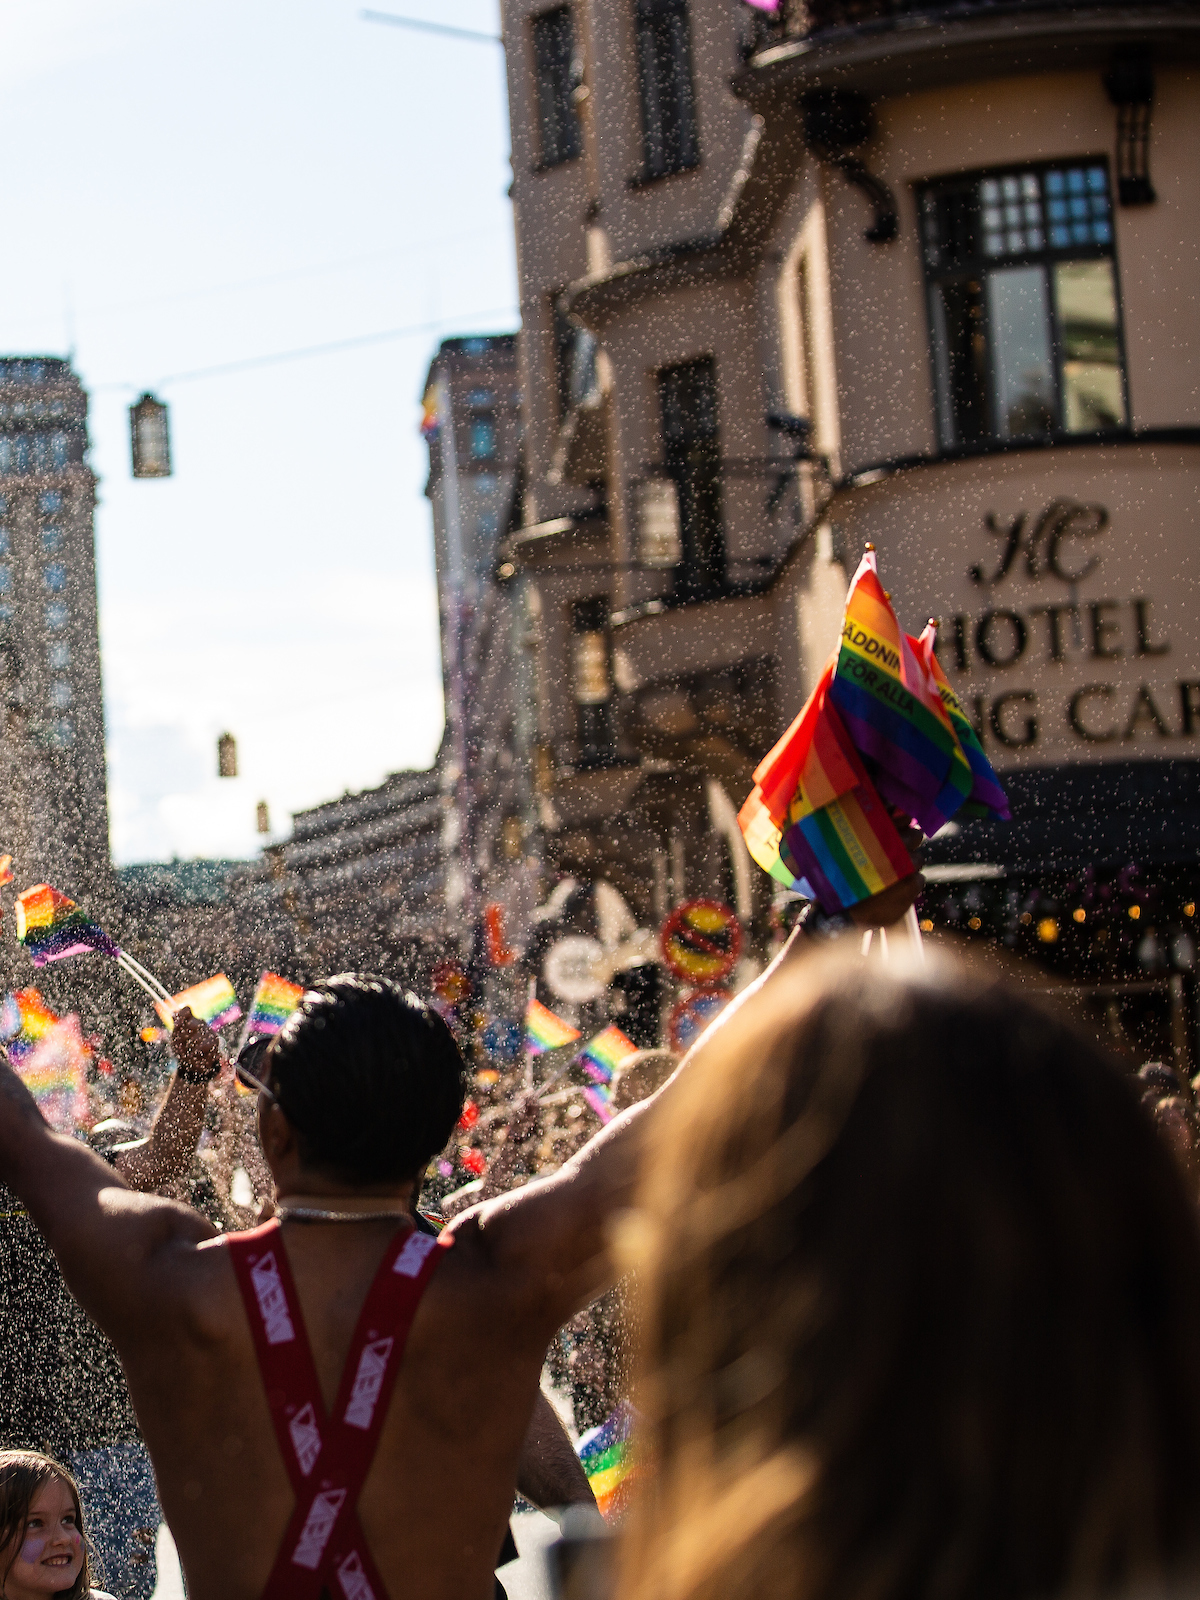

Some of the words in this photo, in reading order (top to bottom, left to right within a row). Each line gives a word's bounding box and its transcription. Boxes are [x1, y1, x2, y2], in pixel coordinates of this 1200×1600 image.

[932, 596, 1171, 671] HOTEL
[843, 656, 879, 688] FÖR
[876, 680, 915, 715] ALLA
